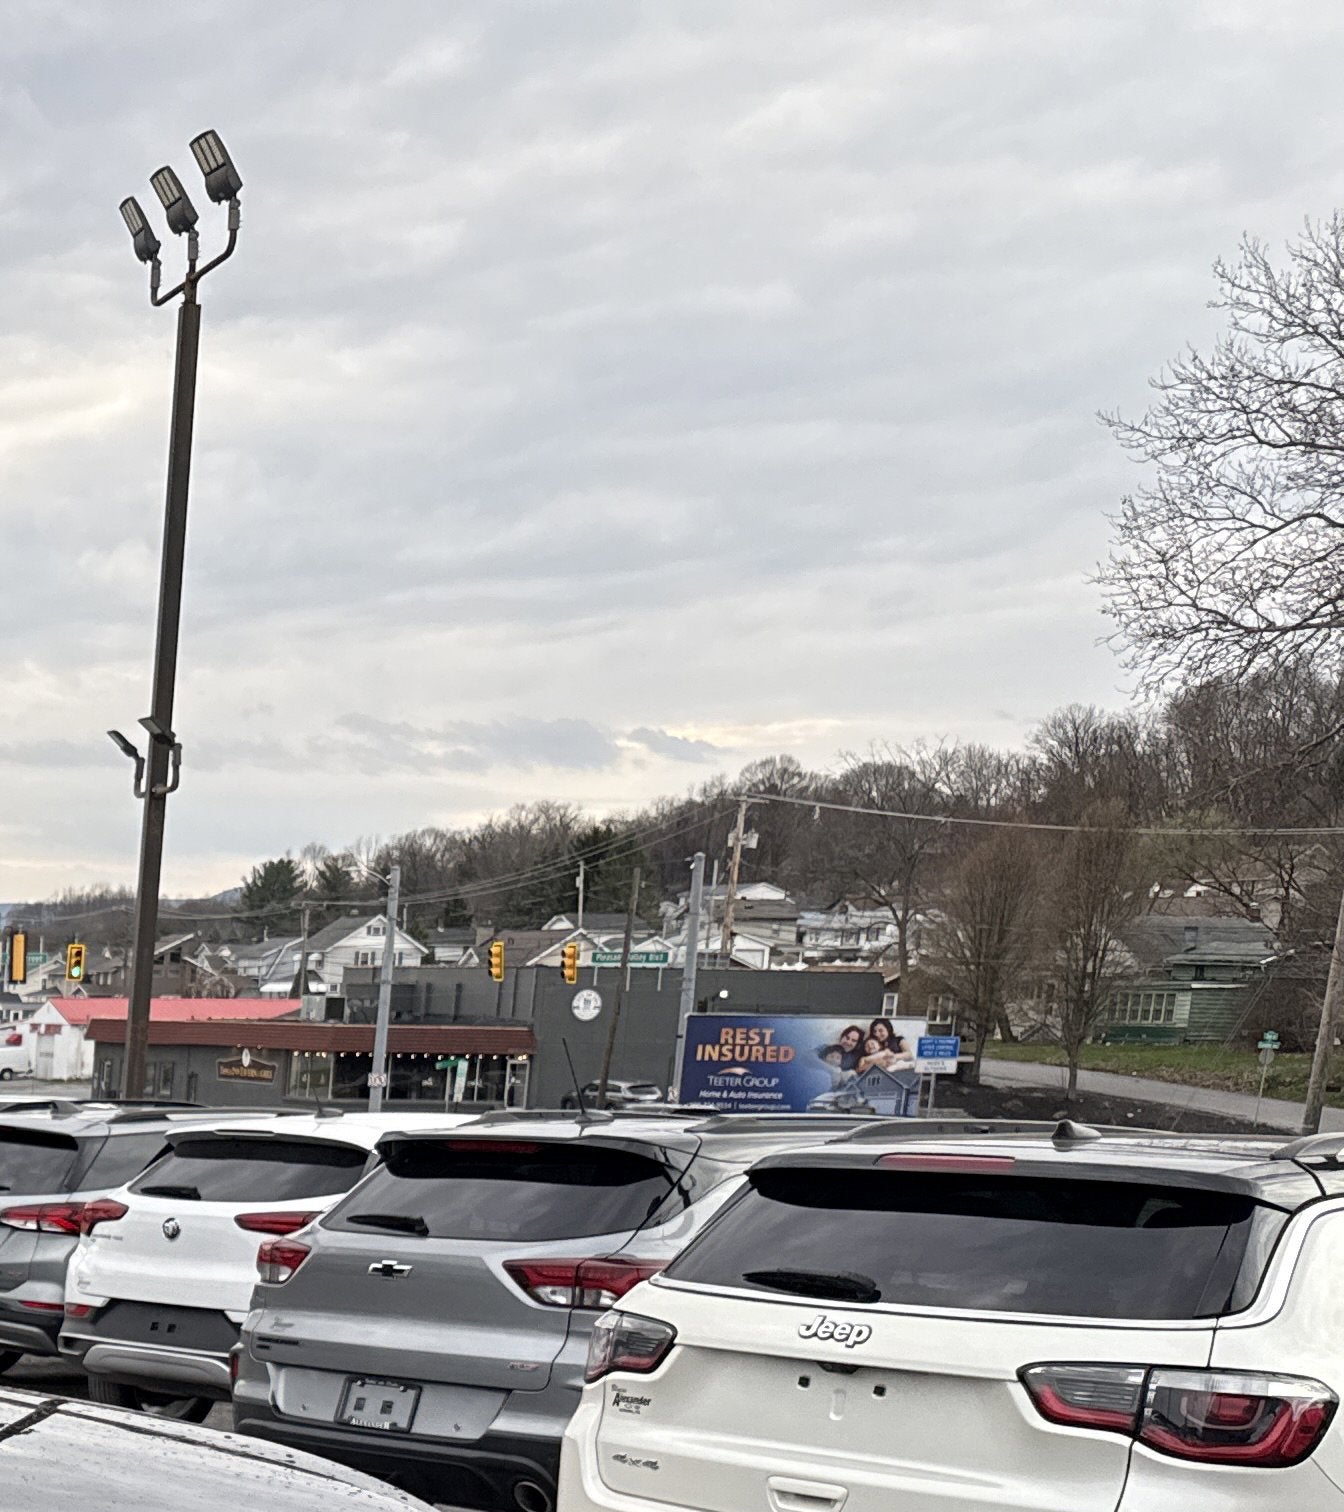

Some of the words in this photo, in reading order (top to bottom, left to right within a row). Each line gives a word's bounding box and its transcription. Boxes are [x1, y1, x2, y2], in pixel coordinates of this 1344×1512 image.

[719, 1027, 775, 1045] REST
[695, 1044, 796, 1064] INSURED
[798, 1314, 873, 1349] Jeep
